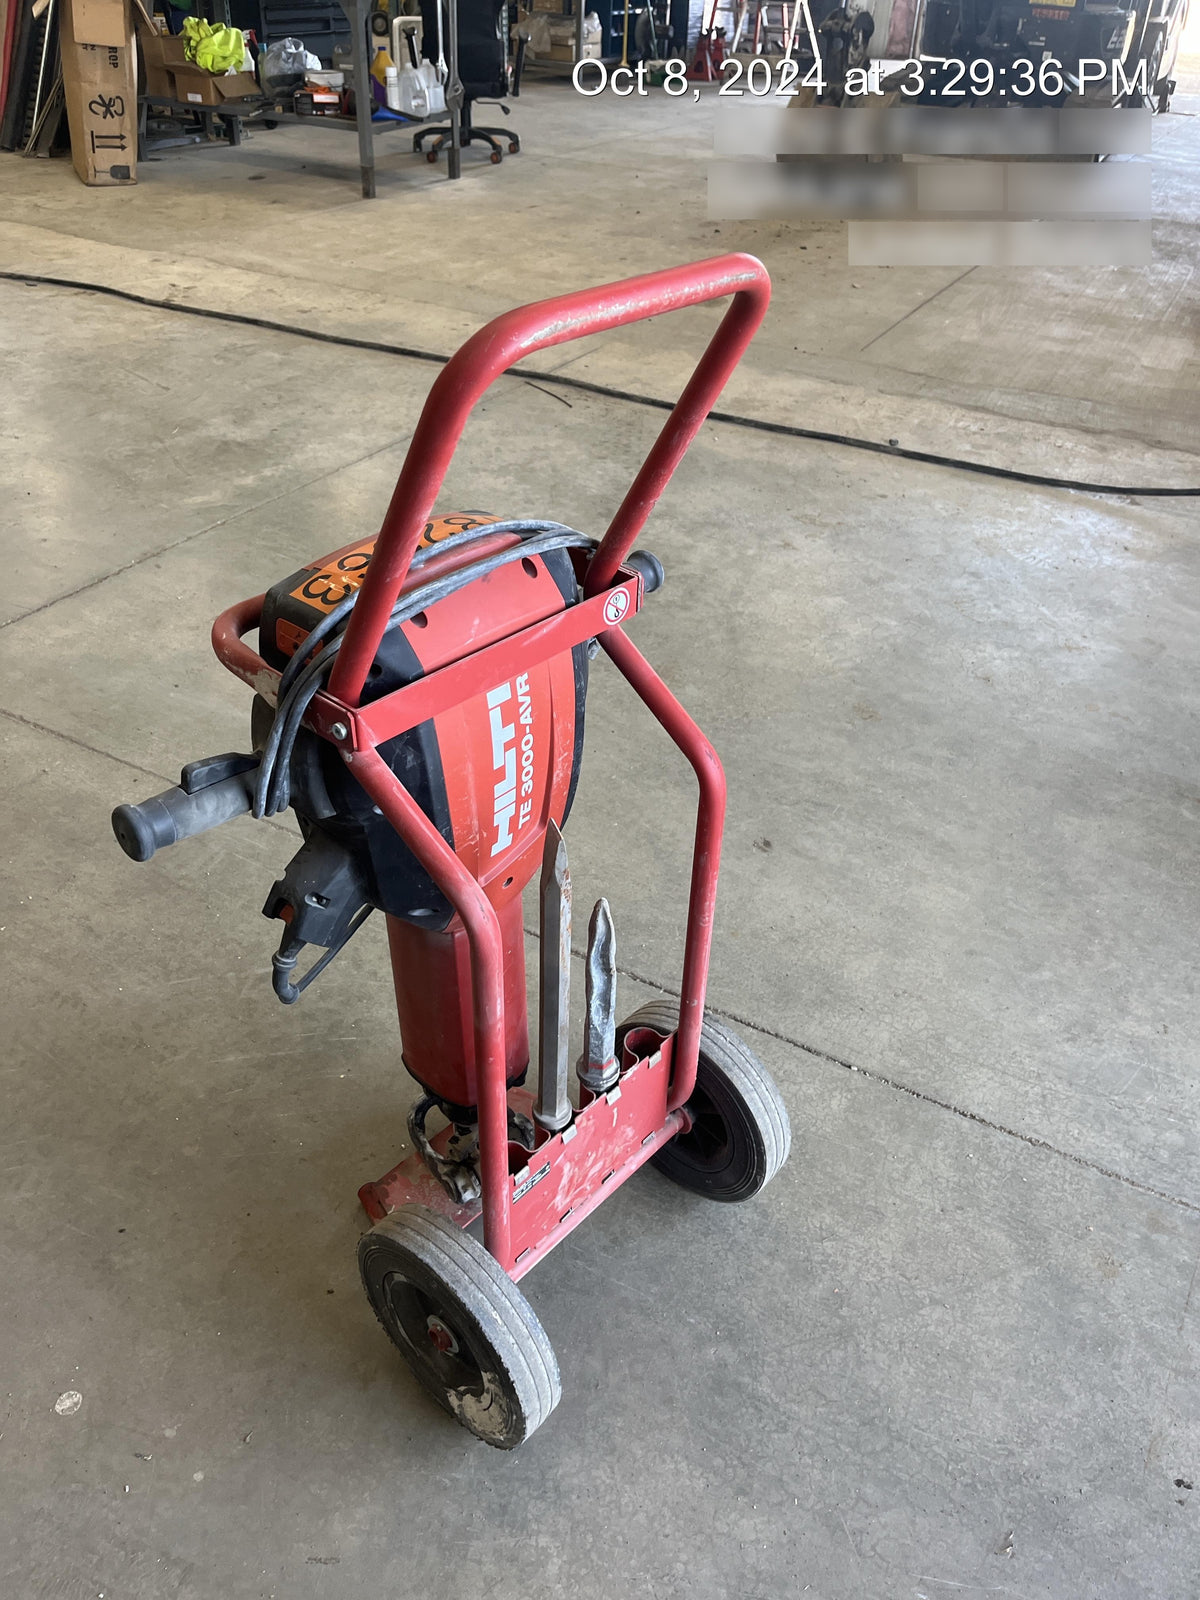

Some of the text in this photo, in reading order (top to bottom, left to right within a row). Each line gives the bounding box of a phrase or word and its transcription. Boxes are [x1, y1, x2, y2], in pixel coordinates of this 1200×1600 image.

[486, 681, 517, 857] HILTI
[516, 672, 534, 830] TE 3000-AVR
